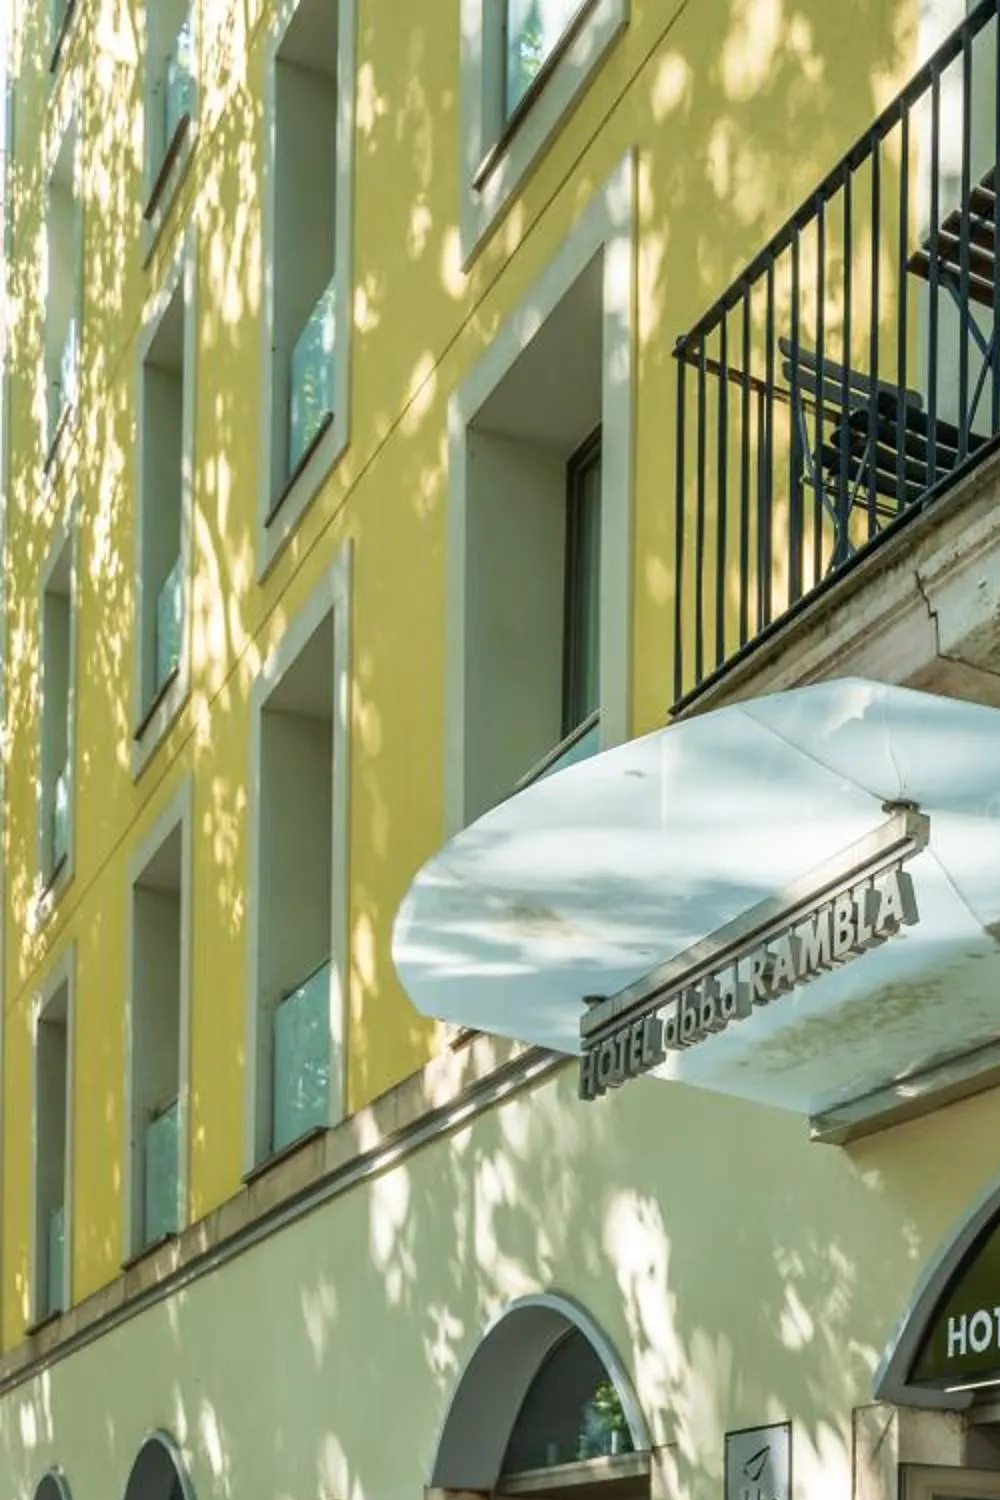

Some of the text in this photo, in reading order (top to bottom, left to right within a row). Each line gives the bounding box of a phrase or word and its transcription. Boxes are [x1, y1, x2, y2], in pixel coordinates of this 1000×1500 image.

[579, 864, 920, 1100] HOTEL abba RAMBLA
